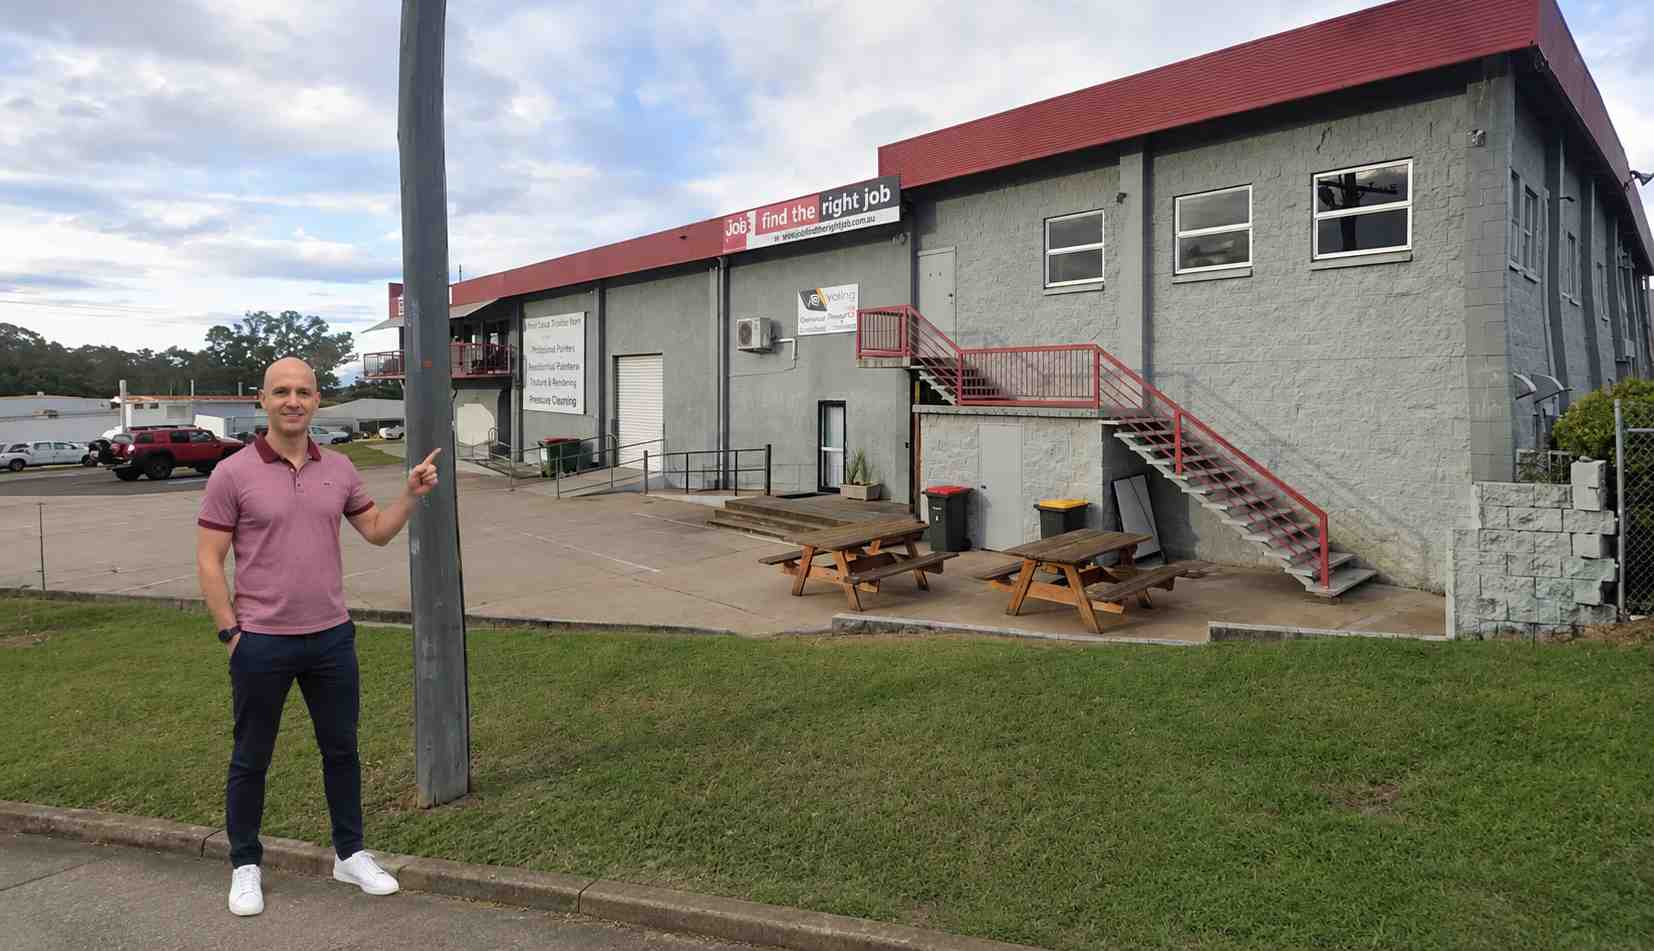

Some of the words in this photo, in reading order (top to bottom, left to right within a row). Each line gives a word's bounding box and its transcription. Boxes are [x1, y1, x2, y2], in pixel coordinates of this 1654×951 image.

[762, 208, 788, 229] find
[792, 205, 816, 223] the
[822, 192, 860, 217] right
[863, 184, 891, 211] job
[552, 394, 577, 408] Cleaning
